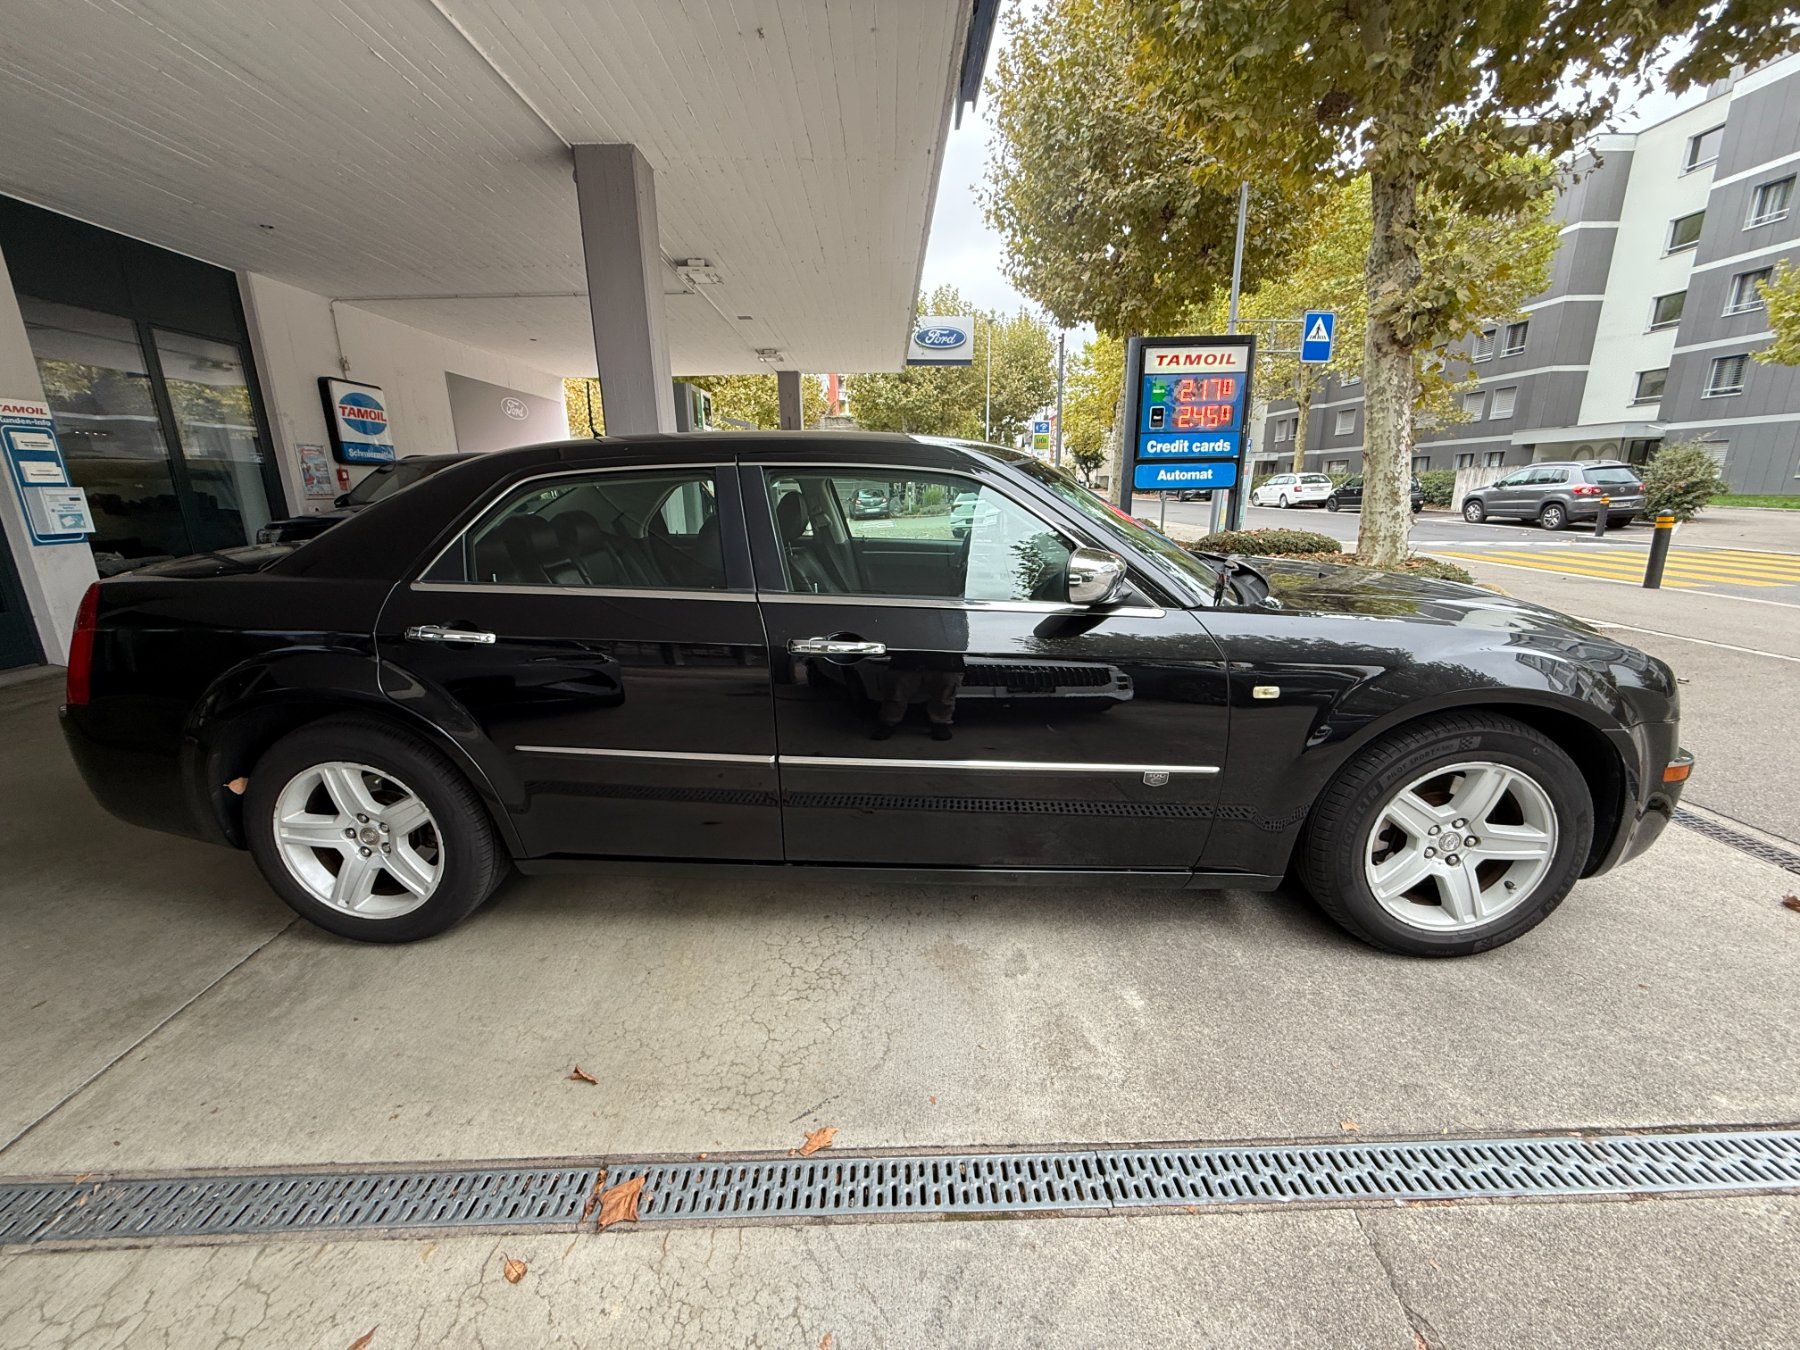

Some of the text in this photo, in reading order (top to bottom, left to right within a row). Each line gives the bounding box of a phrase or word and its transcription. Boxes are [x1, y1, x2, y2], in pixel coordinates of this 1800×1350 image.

[925, 329, 956, 344] Ford
[1155, 353, 1237, 367] TAMOIL
[338, 405, 387, 422] TAMOIL
[506, 399, 524, 417] Ford
[1177, 404, 1232, 428] 2.450
[1146, 439, 1232, 453] Credit cards
[1157, 469, 1214, 481] Automat
